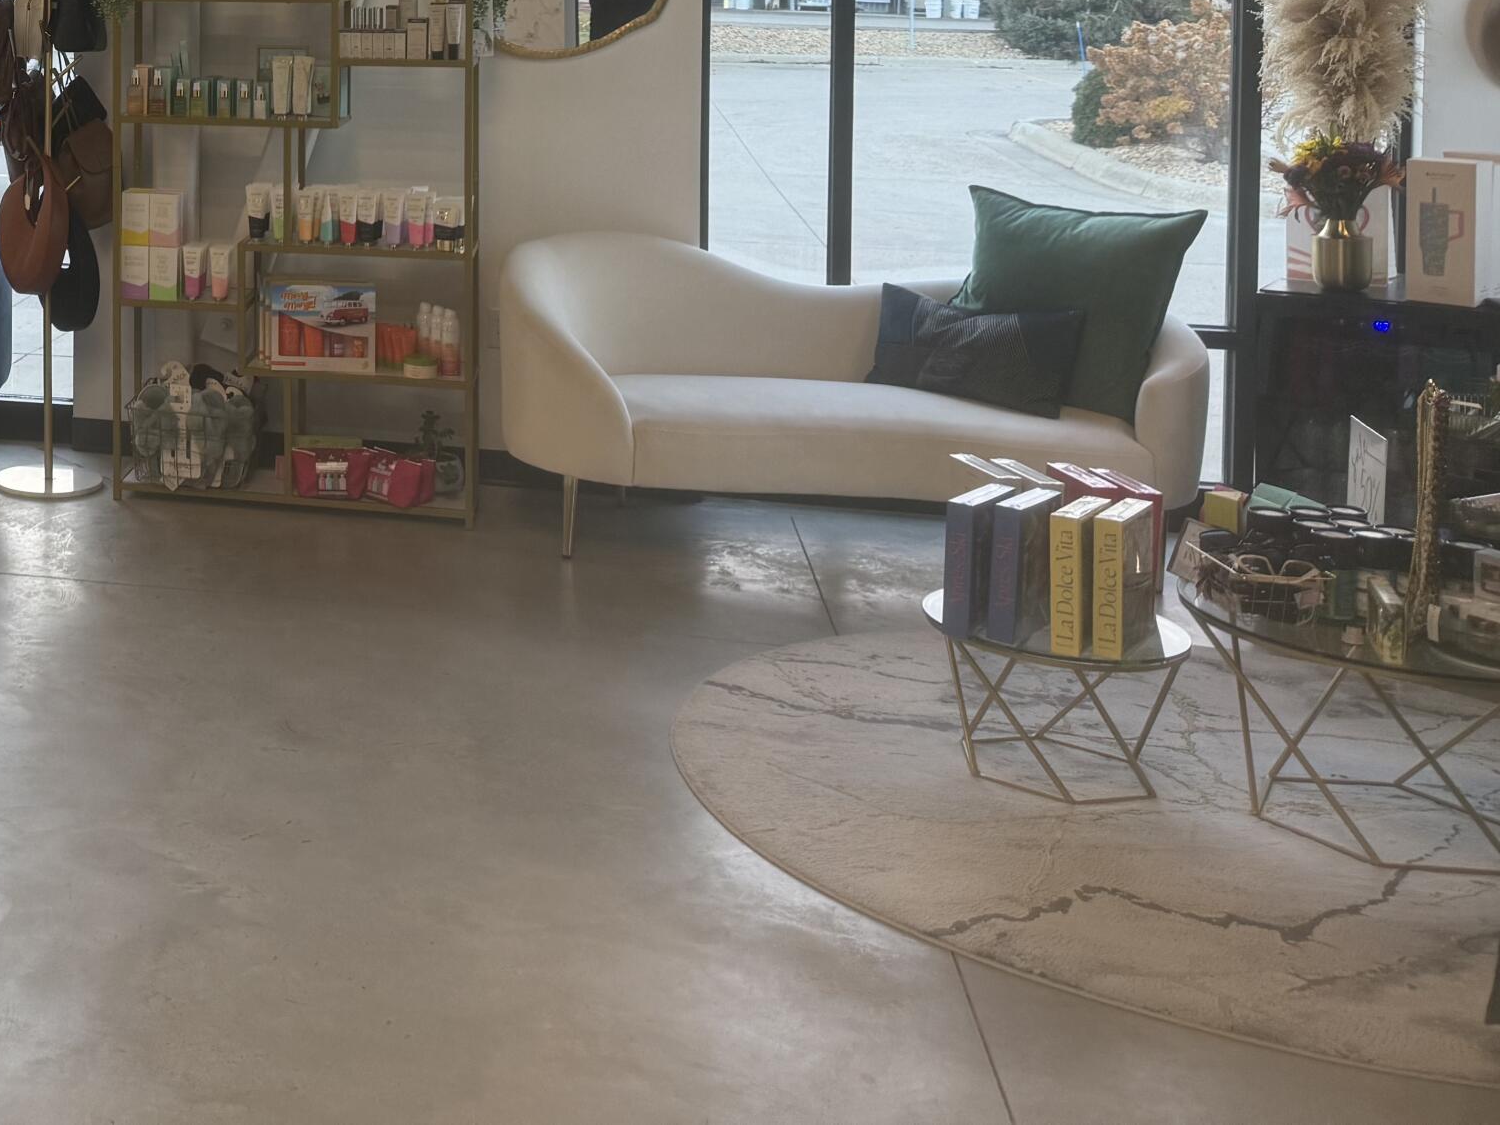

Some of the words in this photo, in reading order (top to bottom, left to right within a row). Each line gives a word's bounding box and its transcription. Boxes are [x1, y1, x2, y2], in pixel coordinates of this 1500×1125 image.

[1055, 530, 1074, 561] Vita
[1098, 533, 1117, 564] Vita
[1056, 566, 1074, 616] Dolce
[1098, 568, 1117, 619] Dolce
[1056, 620, 1074, 641] La
[1099, 623, 1117, 644] La
